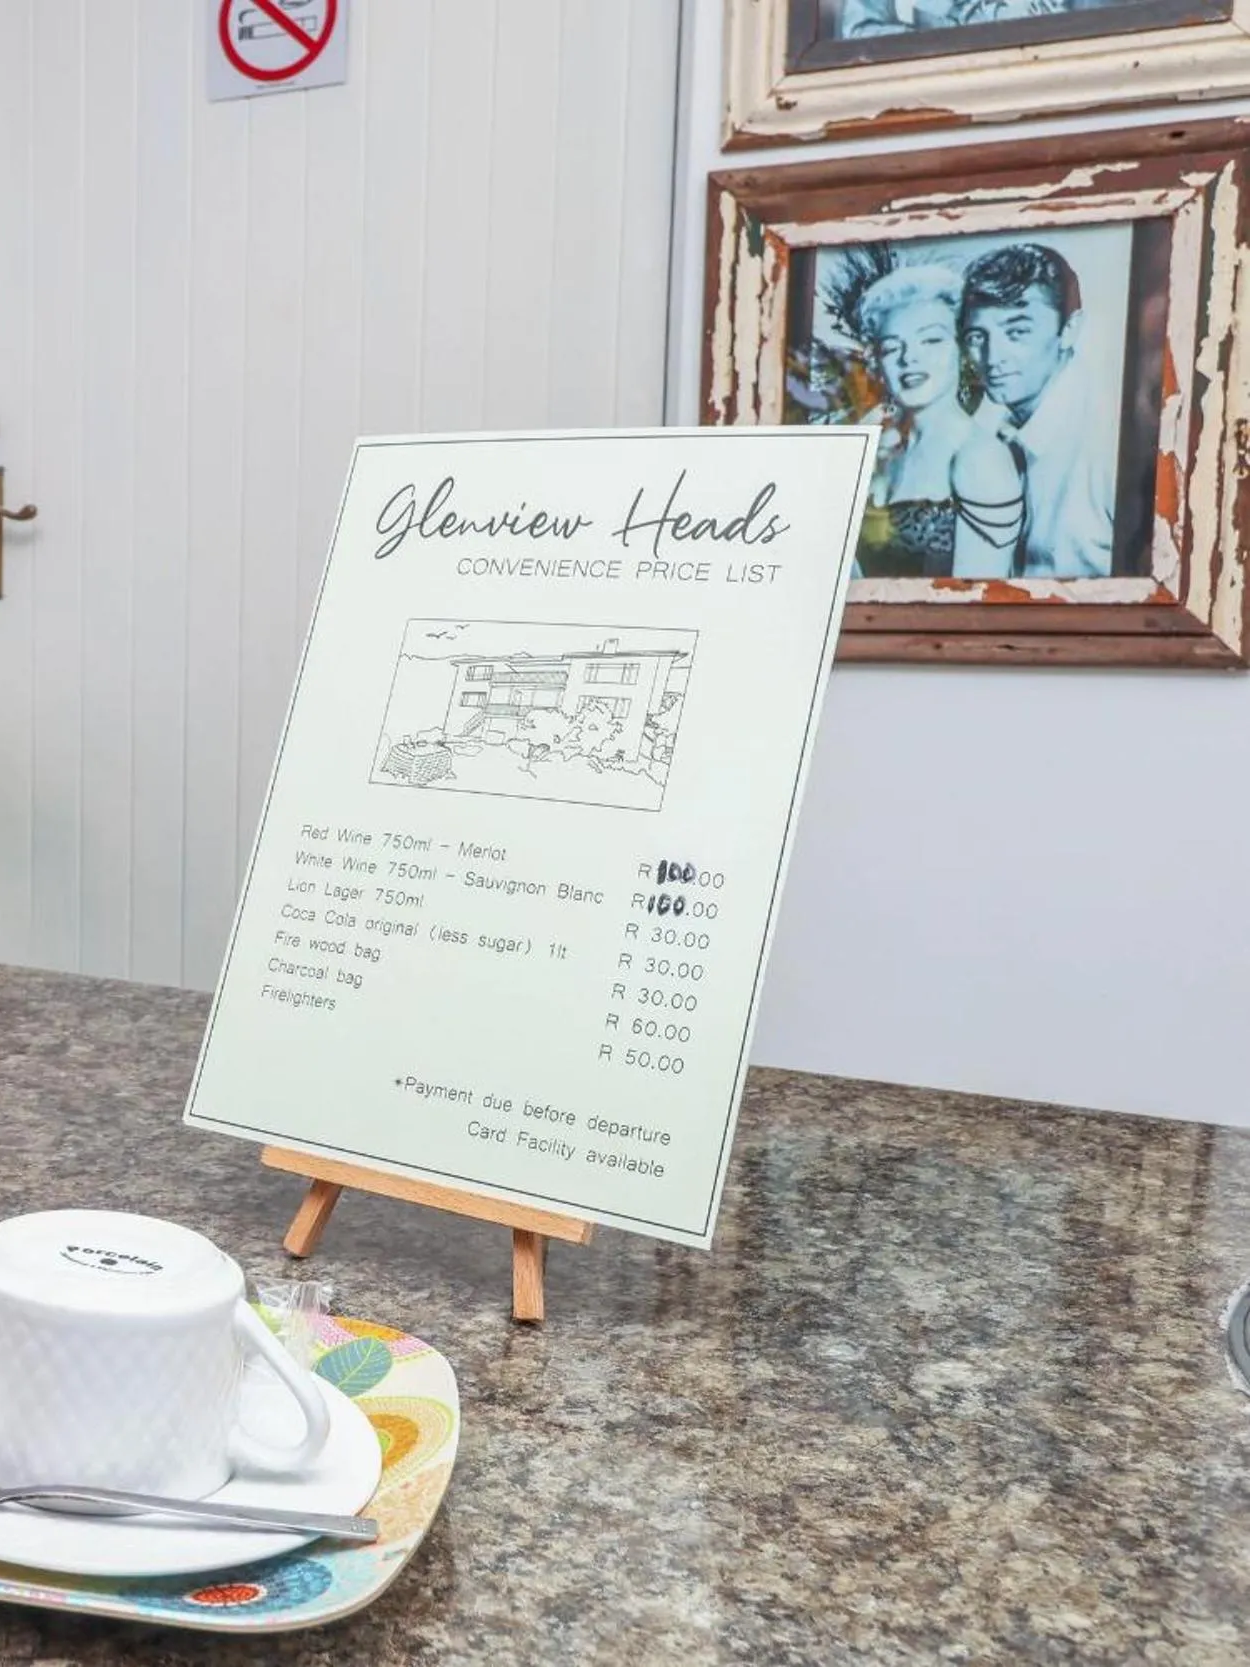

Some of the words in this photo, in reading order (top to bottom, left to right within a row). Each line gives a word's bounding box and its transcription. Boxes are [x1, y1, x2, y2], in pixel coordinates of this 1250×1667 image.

[374, 475, 594, 561] Glenview
[611, 468, 791, 561] Heads
[456, 557, 623, 580] CONVENIENCE
[636, 560, 712, 582] PRICE
[725, 563, 783, 585] LIST
[295, 850, 333, 869] White
[342, 855, 378, 875] Wine
[388, 860, 438, 881] 750ml
[464, 870, 547, 896] Sauvignon
[557, 882, 605, 905] Blanc
[301, 824, 329, 841] Red
[337, 828, 373, 846] Wine
[382, 832, 433, 852] 750ml
[458, 840, 507, 862] Merlot
[281, 903, 316, 922] Coca
[324, 909, 357, 928] Cola
[365, 918, 420, 937] original
[429, 924, 468, 946] (less
[477, 934, 532, 956] sugar)
[618, 952, 633, 970] R
[644, 957, 704, 982] 30.00
[287, 878, 316, 893] Lion
[323, 881, 365, 902] Lager
[375, 887, 425, 908] 750ml
[625, 922, 640, 941] R
[650, 926, 711, 951] 30.00
[267, 957, 329, 980] Charcoal
[336, 967, 364, 990] bag
[605, 1012, 620, 1031] R
[631, 1017, 691, 1043] 60.00
[274, 929, 301, 948] Fire
[309, 939, 347, 955] wood
[354, 942, 382, 964] bag
[611, 982, 626, 1001] R
[637, 987, 698, 1013] 30.00
[260, 984, 337, 1012] Firelighters
[598, 1043, 613, 1062] R
[624, 1048, 685, 1075] 50.00
[467, 1120, 507, 1144] Card
[516, 1130, 576, 1162] Facility
[585, 1147, 665, 1178] available
[482, 1092, 513, 1113] due
[522, 1099, 577, 1126] before
[586, 1114, 671, 1147] departure
